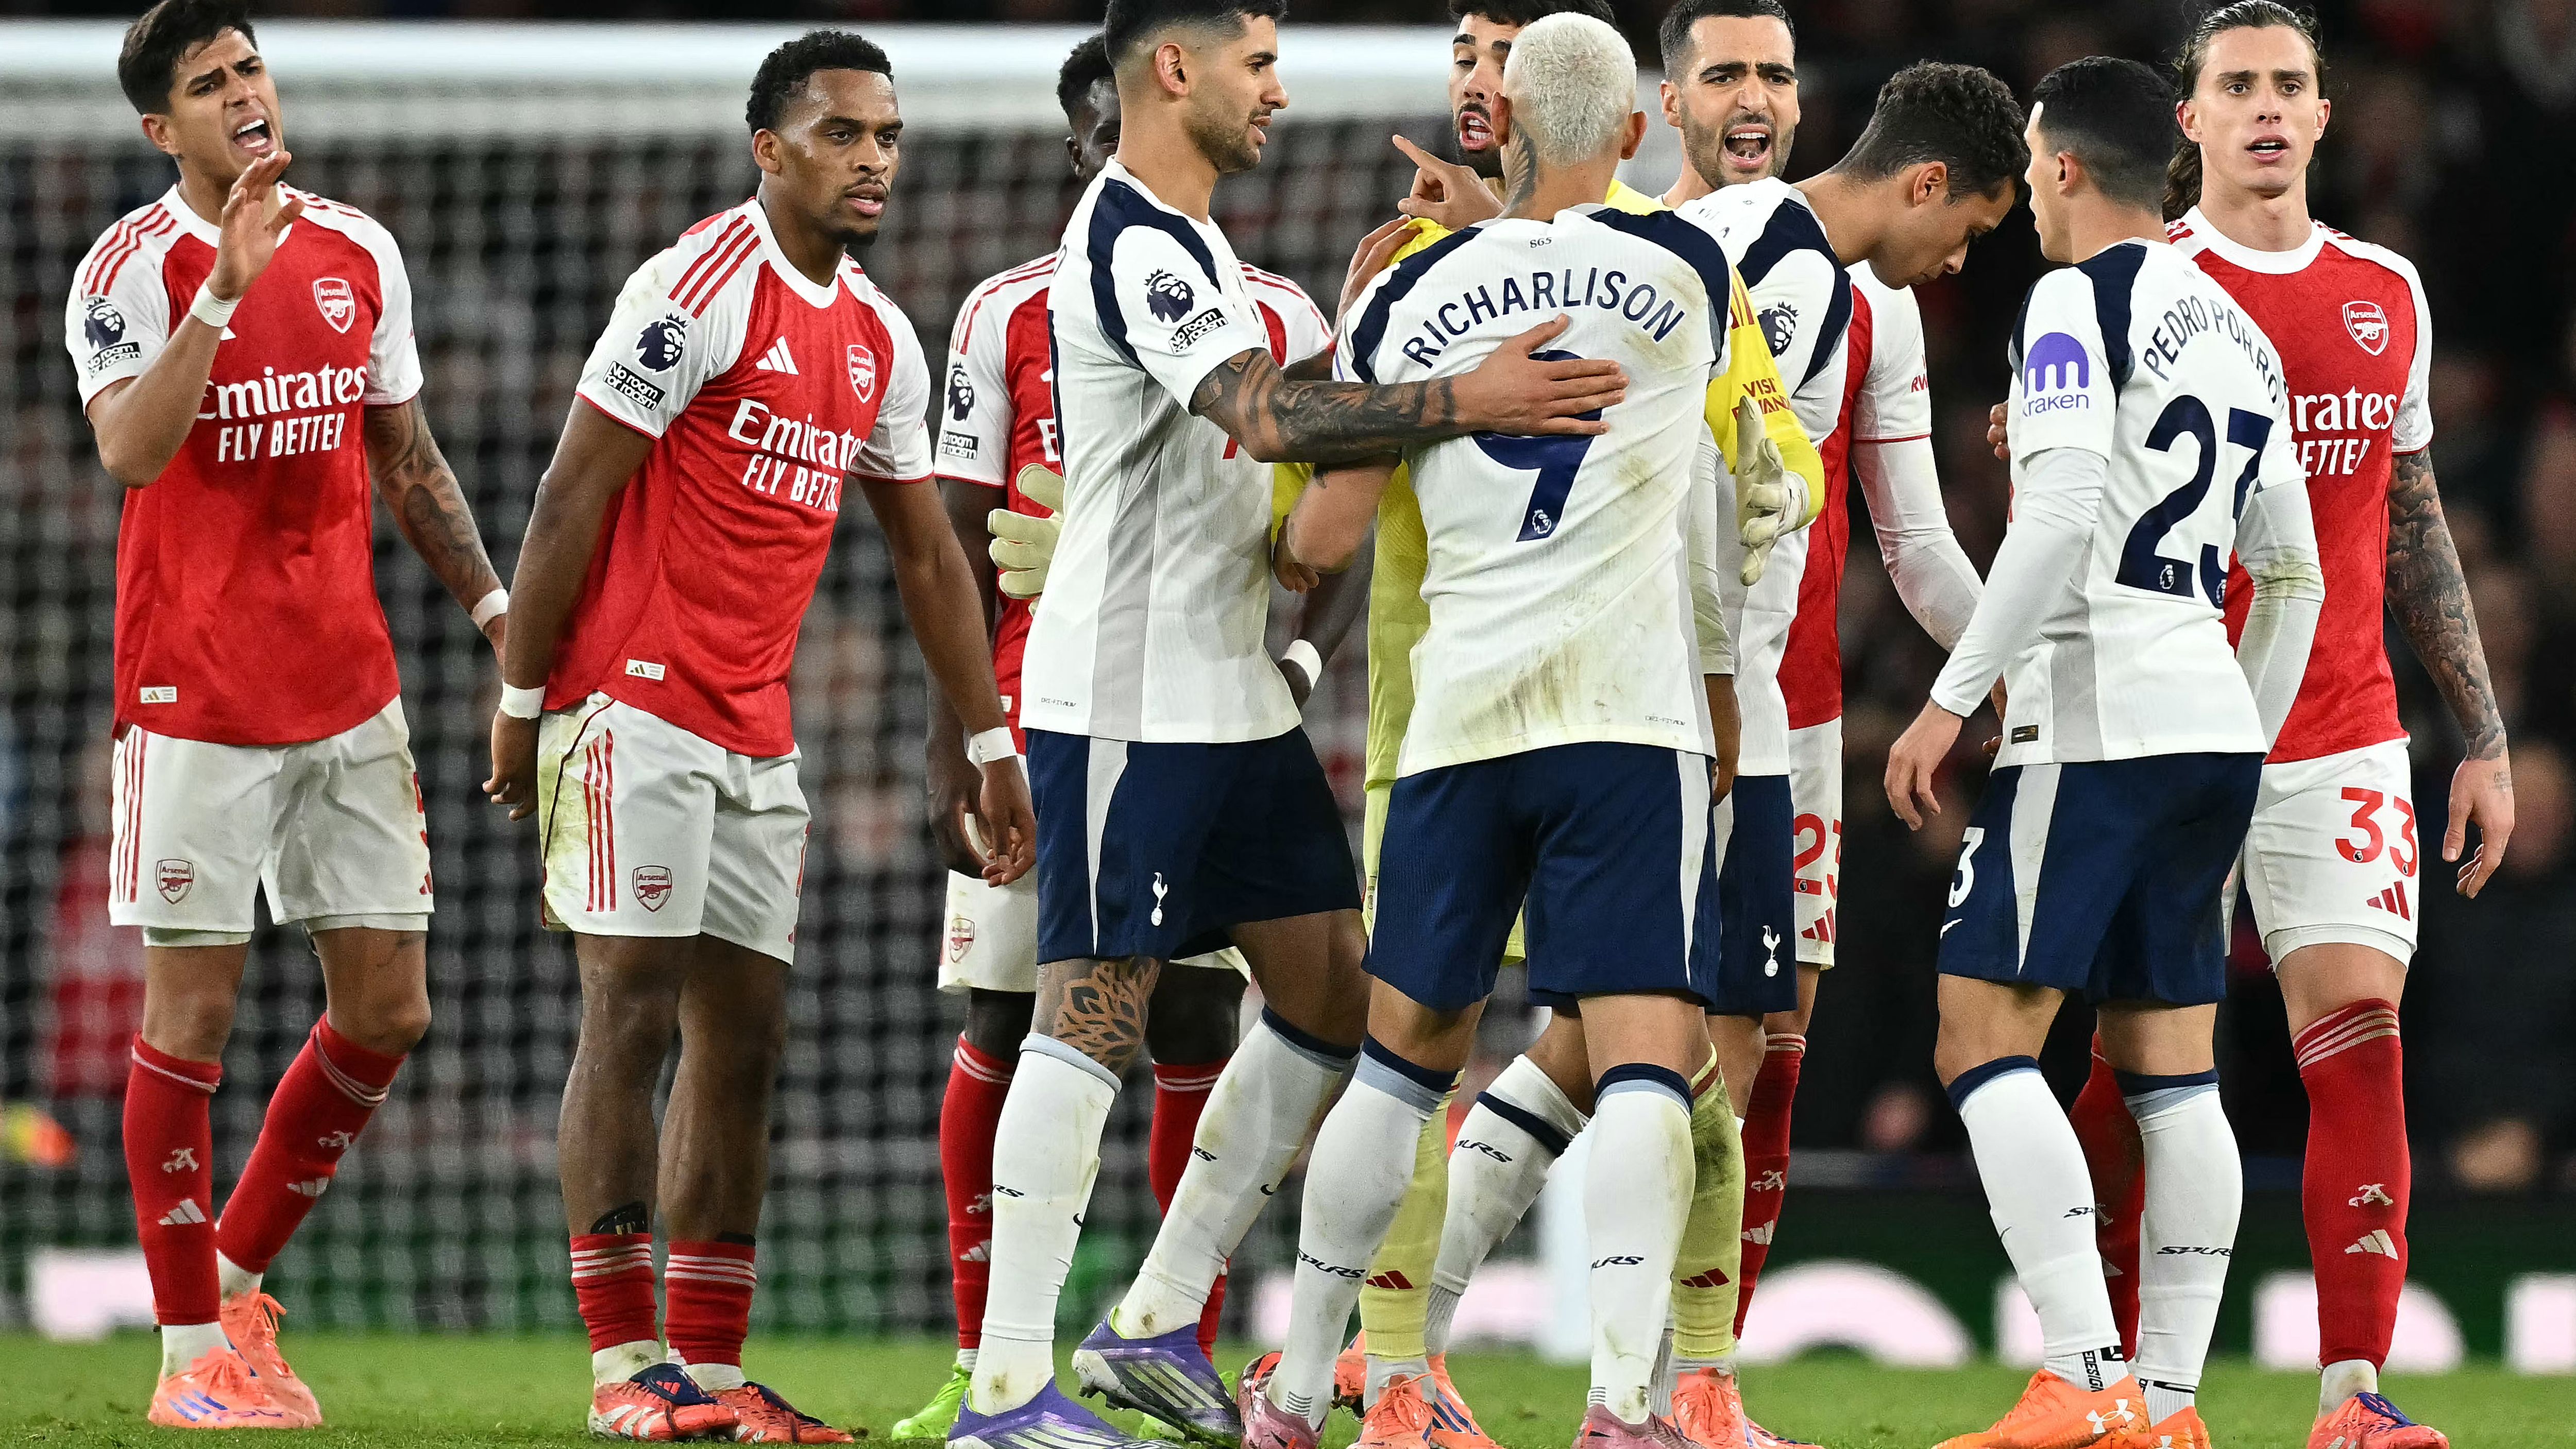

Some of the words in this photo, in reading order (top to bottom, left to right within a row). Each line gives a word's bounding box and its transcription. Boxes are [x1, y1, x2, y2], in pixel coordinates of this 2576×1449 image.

[1530, 237, 1553, 248] 865
[1182, 312, 1217, 335] room
[1188, 317, 1228, 343] racism
[1402, 267, 1685, 369] RICHARLISON
[100, 345, 134, 362] room
[2143, 295, 2208, 382] PEDRO
[2209, 299, 2277, 404] PORRO
[607, 362, 627, 380] No
[626, 374, 658, 399] room
[620, 383, 657, 410] racism
[1742, 377, 1776, 397] VISI
[2293, 385, 2397, 432] rates
[218, 423, 263, 462] FLY
[270, 413, 345, 457] BETTER
[728, 398, 866, 471] Emirate
[742, 453, 788, 495] FLY
[2335, 787, 2417, 877] 33
[2156, 1247, 2232, 1257] SPUR
